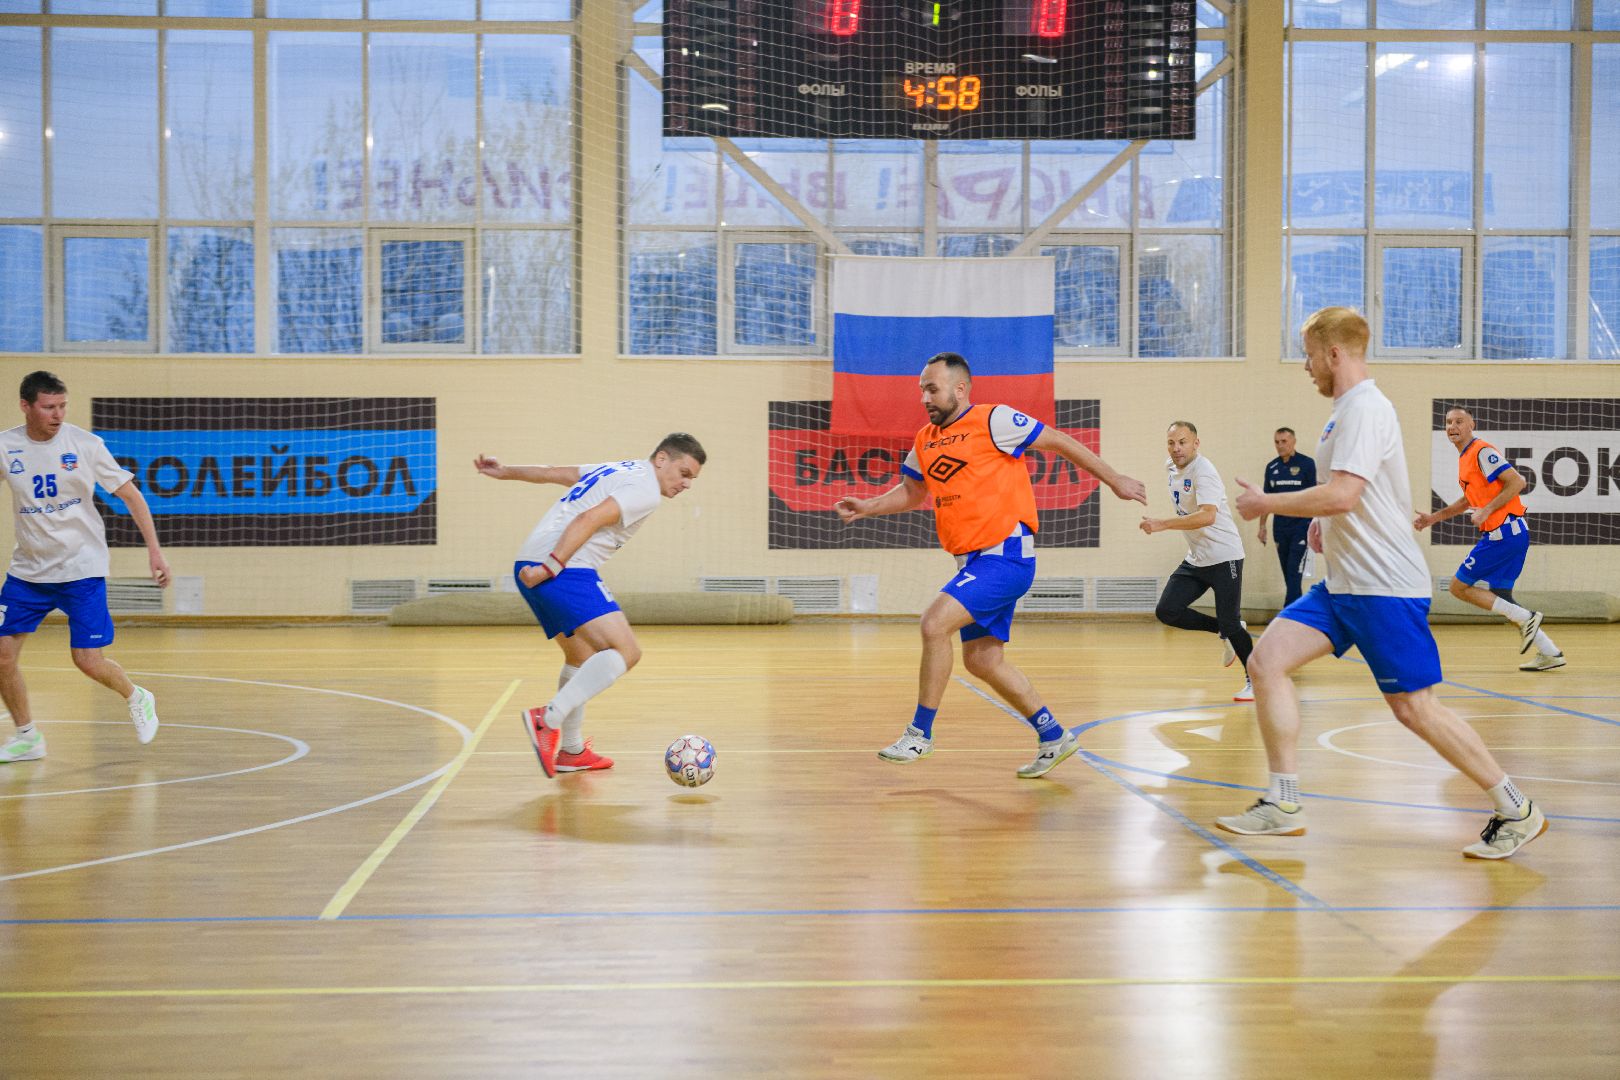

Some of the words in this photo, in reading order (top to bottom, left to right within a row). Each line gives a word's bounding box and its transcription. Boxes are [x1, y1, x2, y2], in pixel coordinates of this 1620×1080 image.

[904, 62, 956, 74] ВРЕМЯ
[798, 83, 846, 97] ФОЛЫ
[904, 76, 981, 110] 4:58
[1015, 84, 1063, 98] ФОЛЫ
[32, 474, 58, 499] 25
[955, 571, 977, 588] 7
